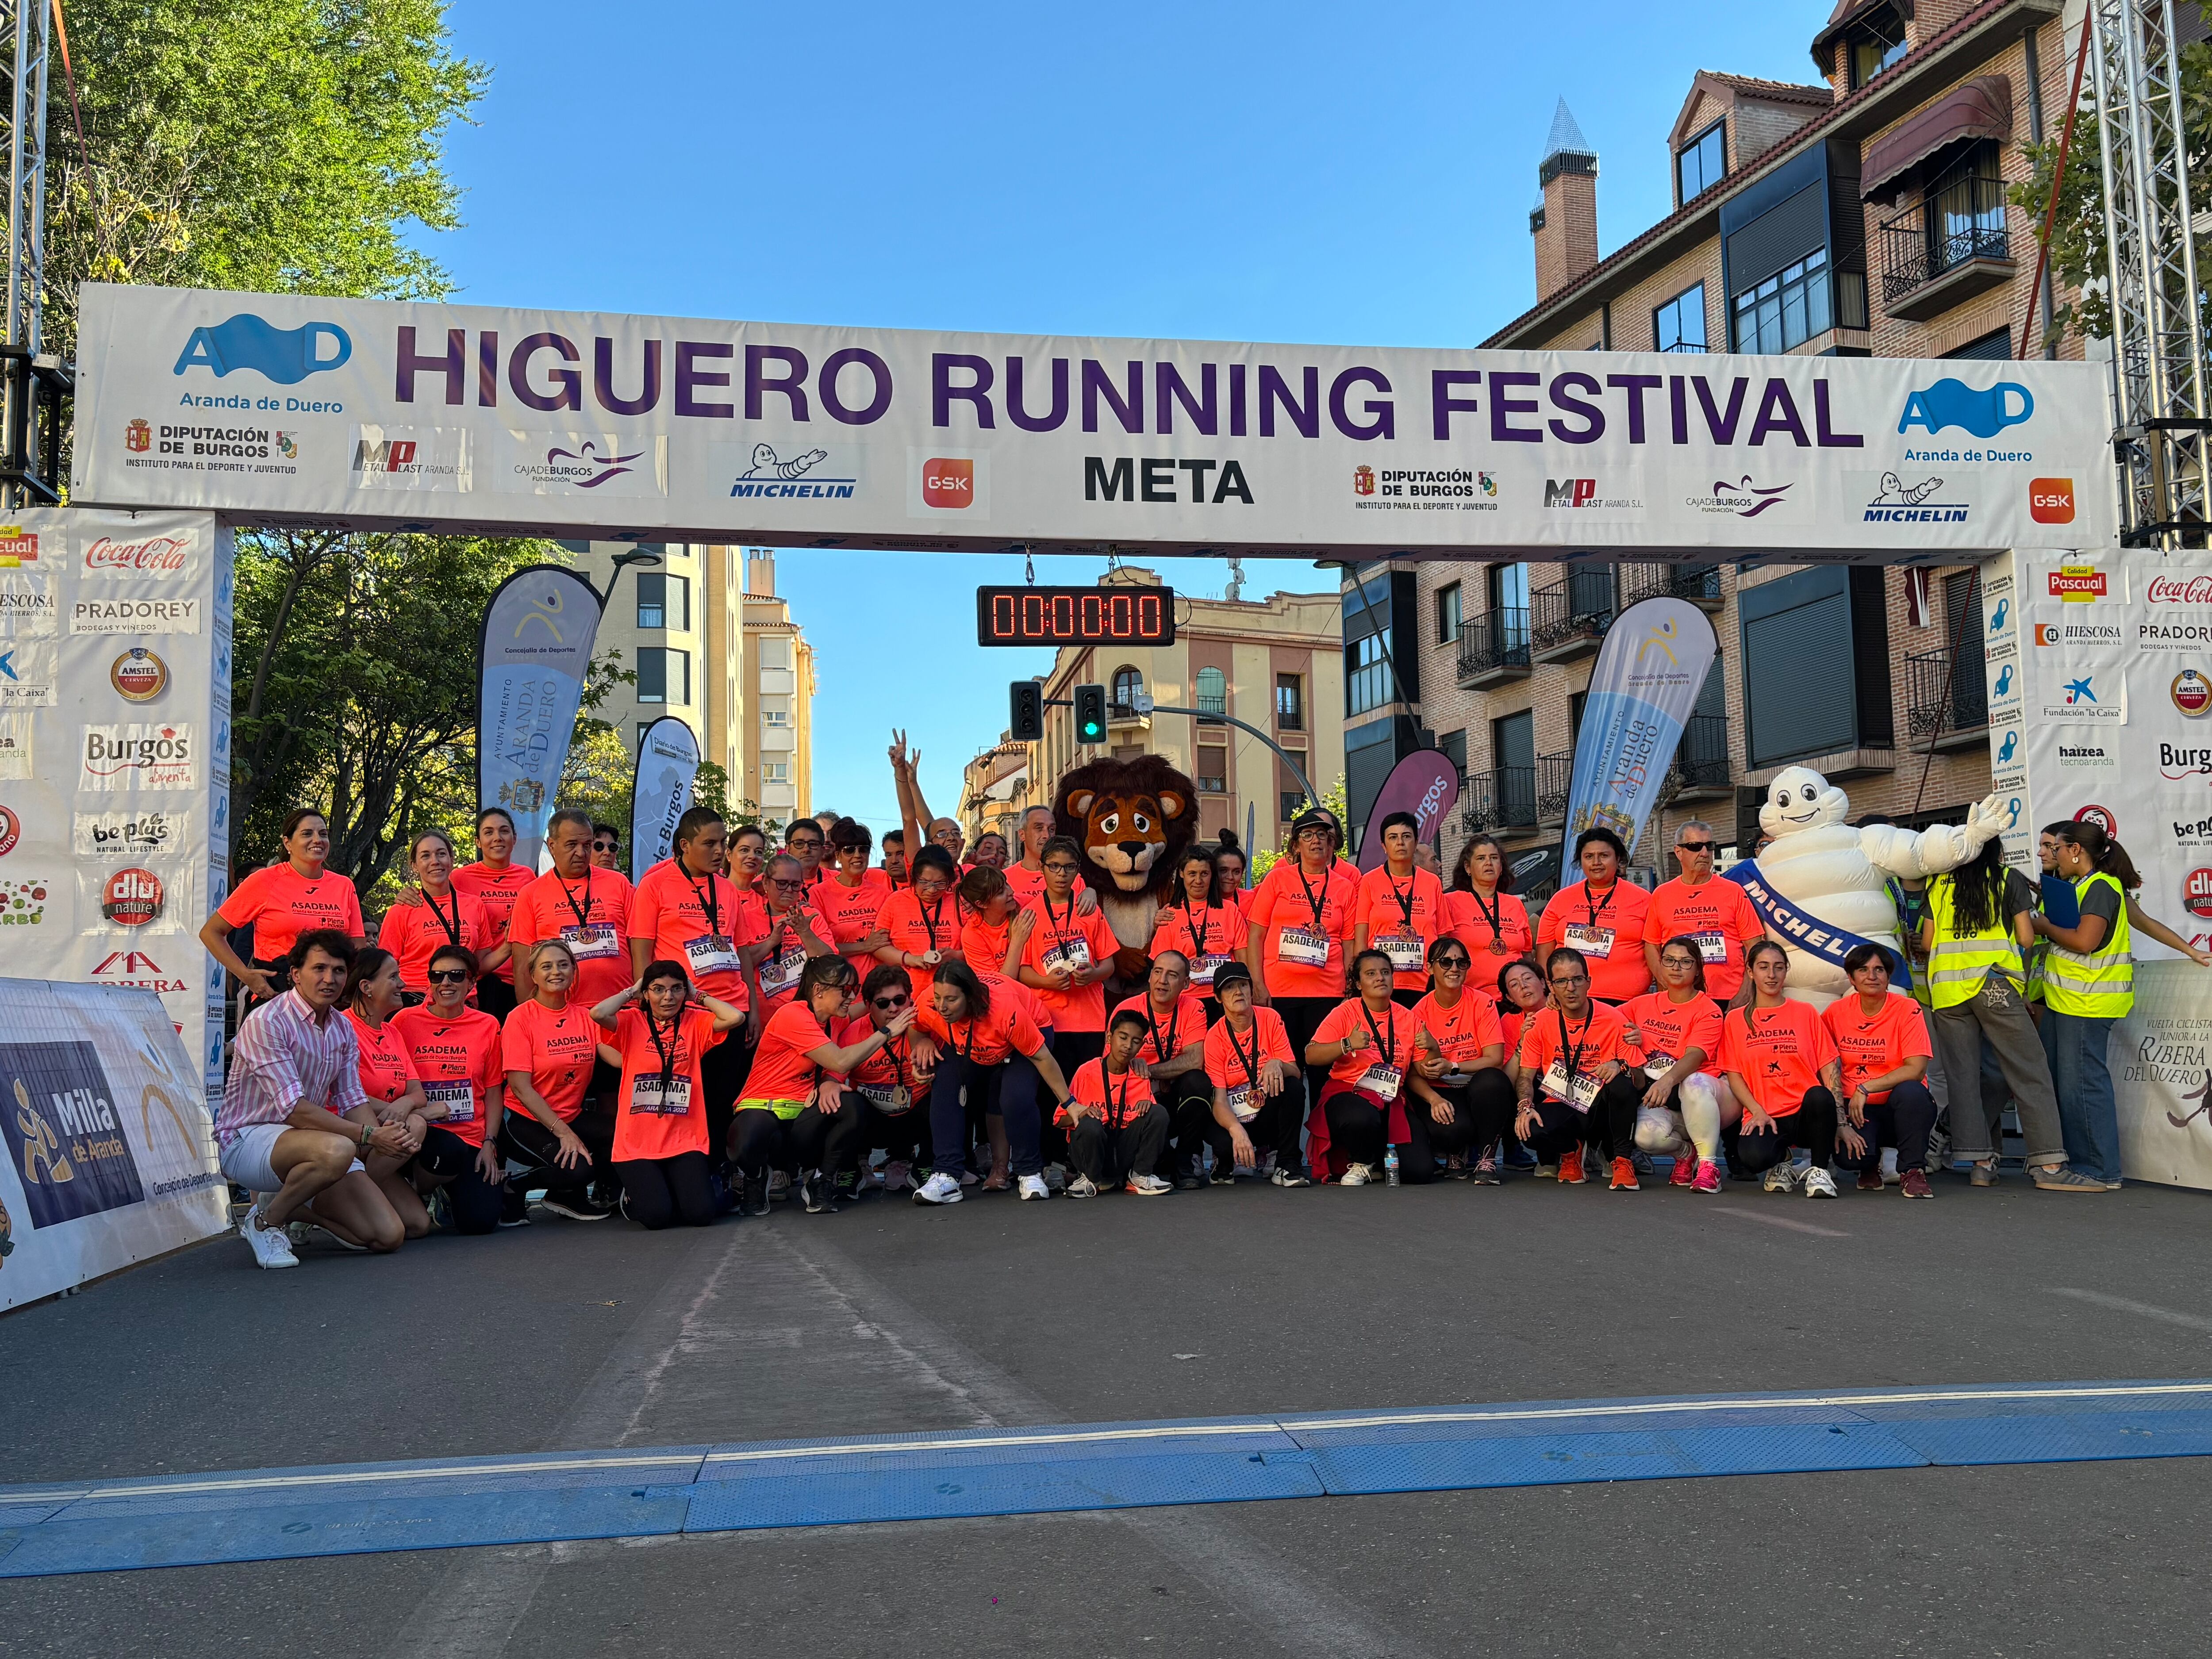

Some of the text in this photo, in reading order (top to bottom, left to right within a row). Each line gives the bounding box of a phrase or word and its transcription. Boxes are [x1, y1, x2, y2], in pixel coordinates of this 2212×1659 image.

[396, 326, 1864, 448] HIGUERO RUNNING FESTIVAL
[180, 392, 343, 414] Aranda de Duero
[160, 425, 269, 443] DIPUTACIÓN
[160, 442, 269, 458] DE BURGOS
[1905, 449, 2032, 462] Aranda de Duero
[126, 458, 169, 469] INSTITUTO
[172, 461, 194, 469] PARA
[208, 463, 245, 472] DEPORTE
[254, 465, 296, 474] JUVENTUD
[425, 465, 454, 475] ARANDA
[928, 476, 968, 491] GSK
[1084, 457, 1255, 504] META
[1382, 469, 1472, 483] DIPUTACIÓN
[730, 484, 856, 499] MICHELIN
[1382, 485, 1473, 497] DE BURGOS
[2034, 495, 2069, 508] GSK
[1863, 510, 1967, 522] MICHELIN
[86, 537, 192, 569] Coca-Cola
[2051, 576, 2102, 590] Pascual
[76, 602, 194, 620] PRADOREY
[993, 595, 1161, 636] 00:00:00
[2065, 625, 2121, 637] HIESCOSA
[494, 679, 512, 760] AYUNTAMIENTO
[2043, 707, 2085, 717] Fundación
[505, 680, 536, 770] ARANDA
[525, 681, 557, 773] de DUERO
[88, 733, 188, 768] Burgos
[654, 737, 669, 749] Diario
[1593, 710, 1624, 788] AYUNTAMIENTO
[1608, 719, 1645, 798] Aranda
[2059, 746, 2104, 757] haizea
[1625, 725, 1658, 799] de Duero
[2060, 757, 2114, 766] tecnoaranda
[149, 768, 191, 784] alimenta
[660, 780, 684, 842] Burgos
[92, 817, 169, 843] be plus
[2173, 821, 2193, 838] be
[115, 901, 153, 914] nature
[292, 902, 340, 911] ASADEMA
[838, 907, 876, 917] ASADEMA
[1673, 906, 1718, 915] ASADEMA
[1743, 879, 1859, 959] MICHELI
[1283, 934, 1325, 951] ASADEMA
[1378, 943, 1421, 953] ASADEMA
[1643, 1018, 1681, 1033] ASADEMA
[2147, 1019, 2174, 1029] VUELTA
[547, 1035, 589, 1048] ASADEMA
[1746, 1029, 1796, 1041] ASADEMA
[1840, 1035, 1886, 1046] ASADEMA
[2159, 1032, 2188, 1042] JUNIOR
[2199, 1033, 2209, 1041] LA
[415, 1046, 467, 1055] ASADEMA
[2139, 1036, 2205, 1066] RIBERA
[2124, 1064, 2201, 1086] DEL DUERO
[635, 1081, 686, 1094] ASADMA
[52, 1088, 115, 1137] Milla
[1575, 1102, 1588, 1112] 2025
[72, 1134, 124, 1163] de Aranda
